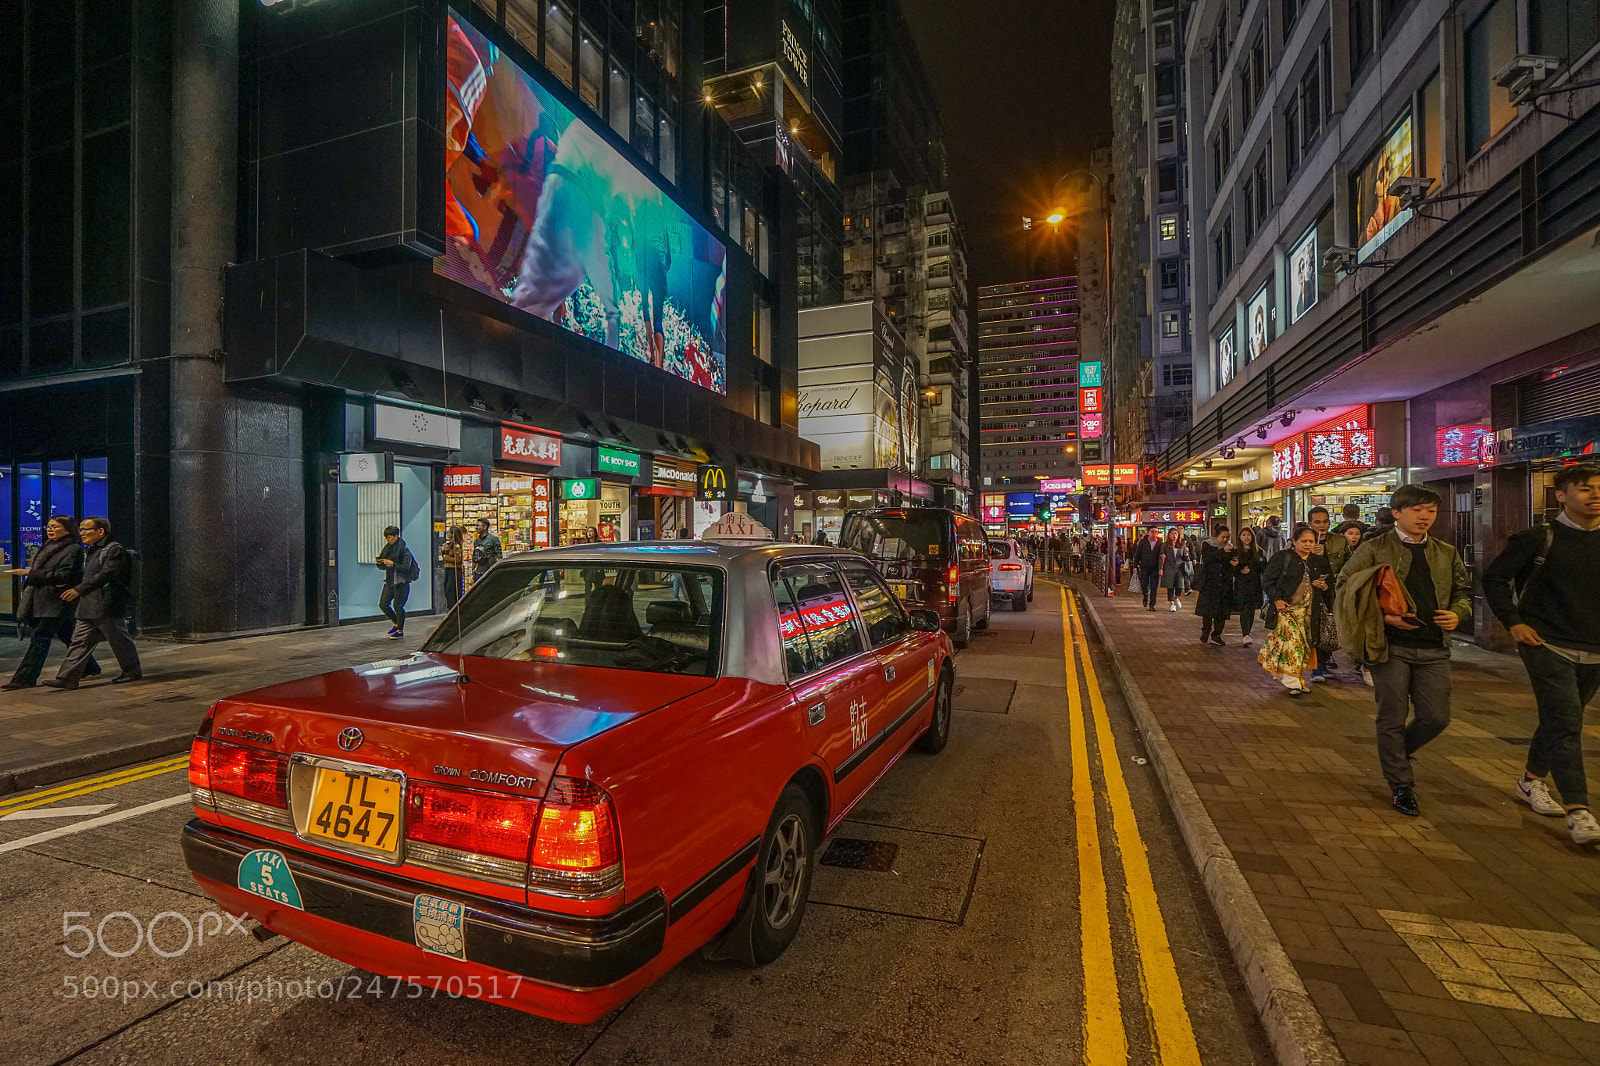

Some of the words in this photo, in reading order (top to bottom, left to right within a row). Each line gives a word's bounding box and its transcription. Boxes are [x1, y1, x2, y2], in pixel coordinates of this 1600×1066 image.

[782, 19, 808, 70] PRINCE
[782, 37, 809, 87] TOWER
[798, 388, 858, 417] hopard
[600, 455, 610, 463] THE
[611, 456, 624, 466] BODY
[658, 468, 697, 482] McDonald's
[600, 501, 621, 509] YOUTH
[716, 524, 754, 535] TAXI
[726, 514, 745, 524] 的士
[850, 695, 867, 726] 的士
[851, 717, 868, 750] TAXI
[433, 765, 461, 777] CROWN
[468, 769, 537, 789] COMFORT
[345, 772, 376, 809] TL
[316, 801, 395, 846] 4647
[255, 851, 282, 869] TAXI
[261, 864, 274, 886] 5
[249, 881, 289, 903] SEATS
